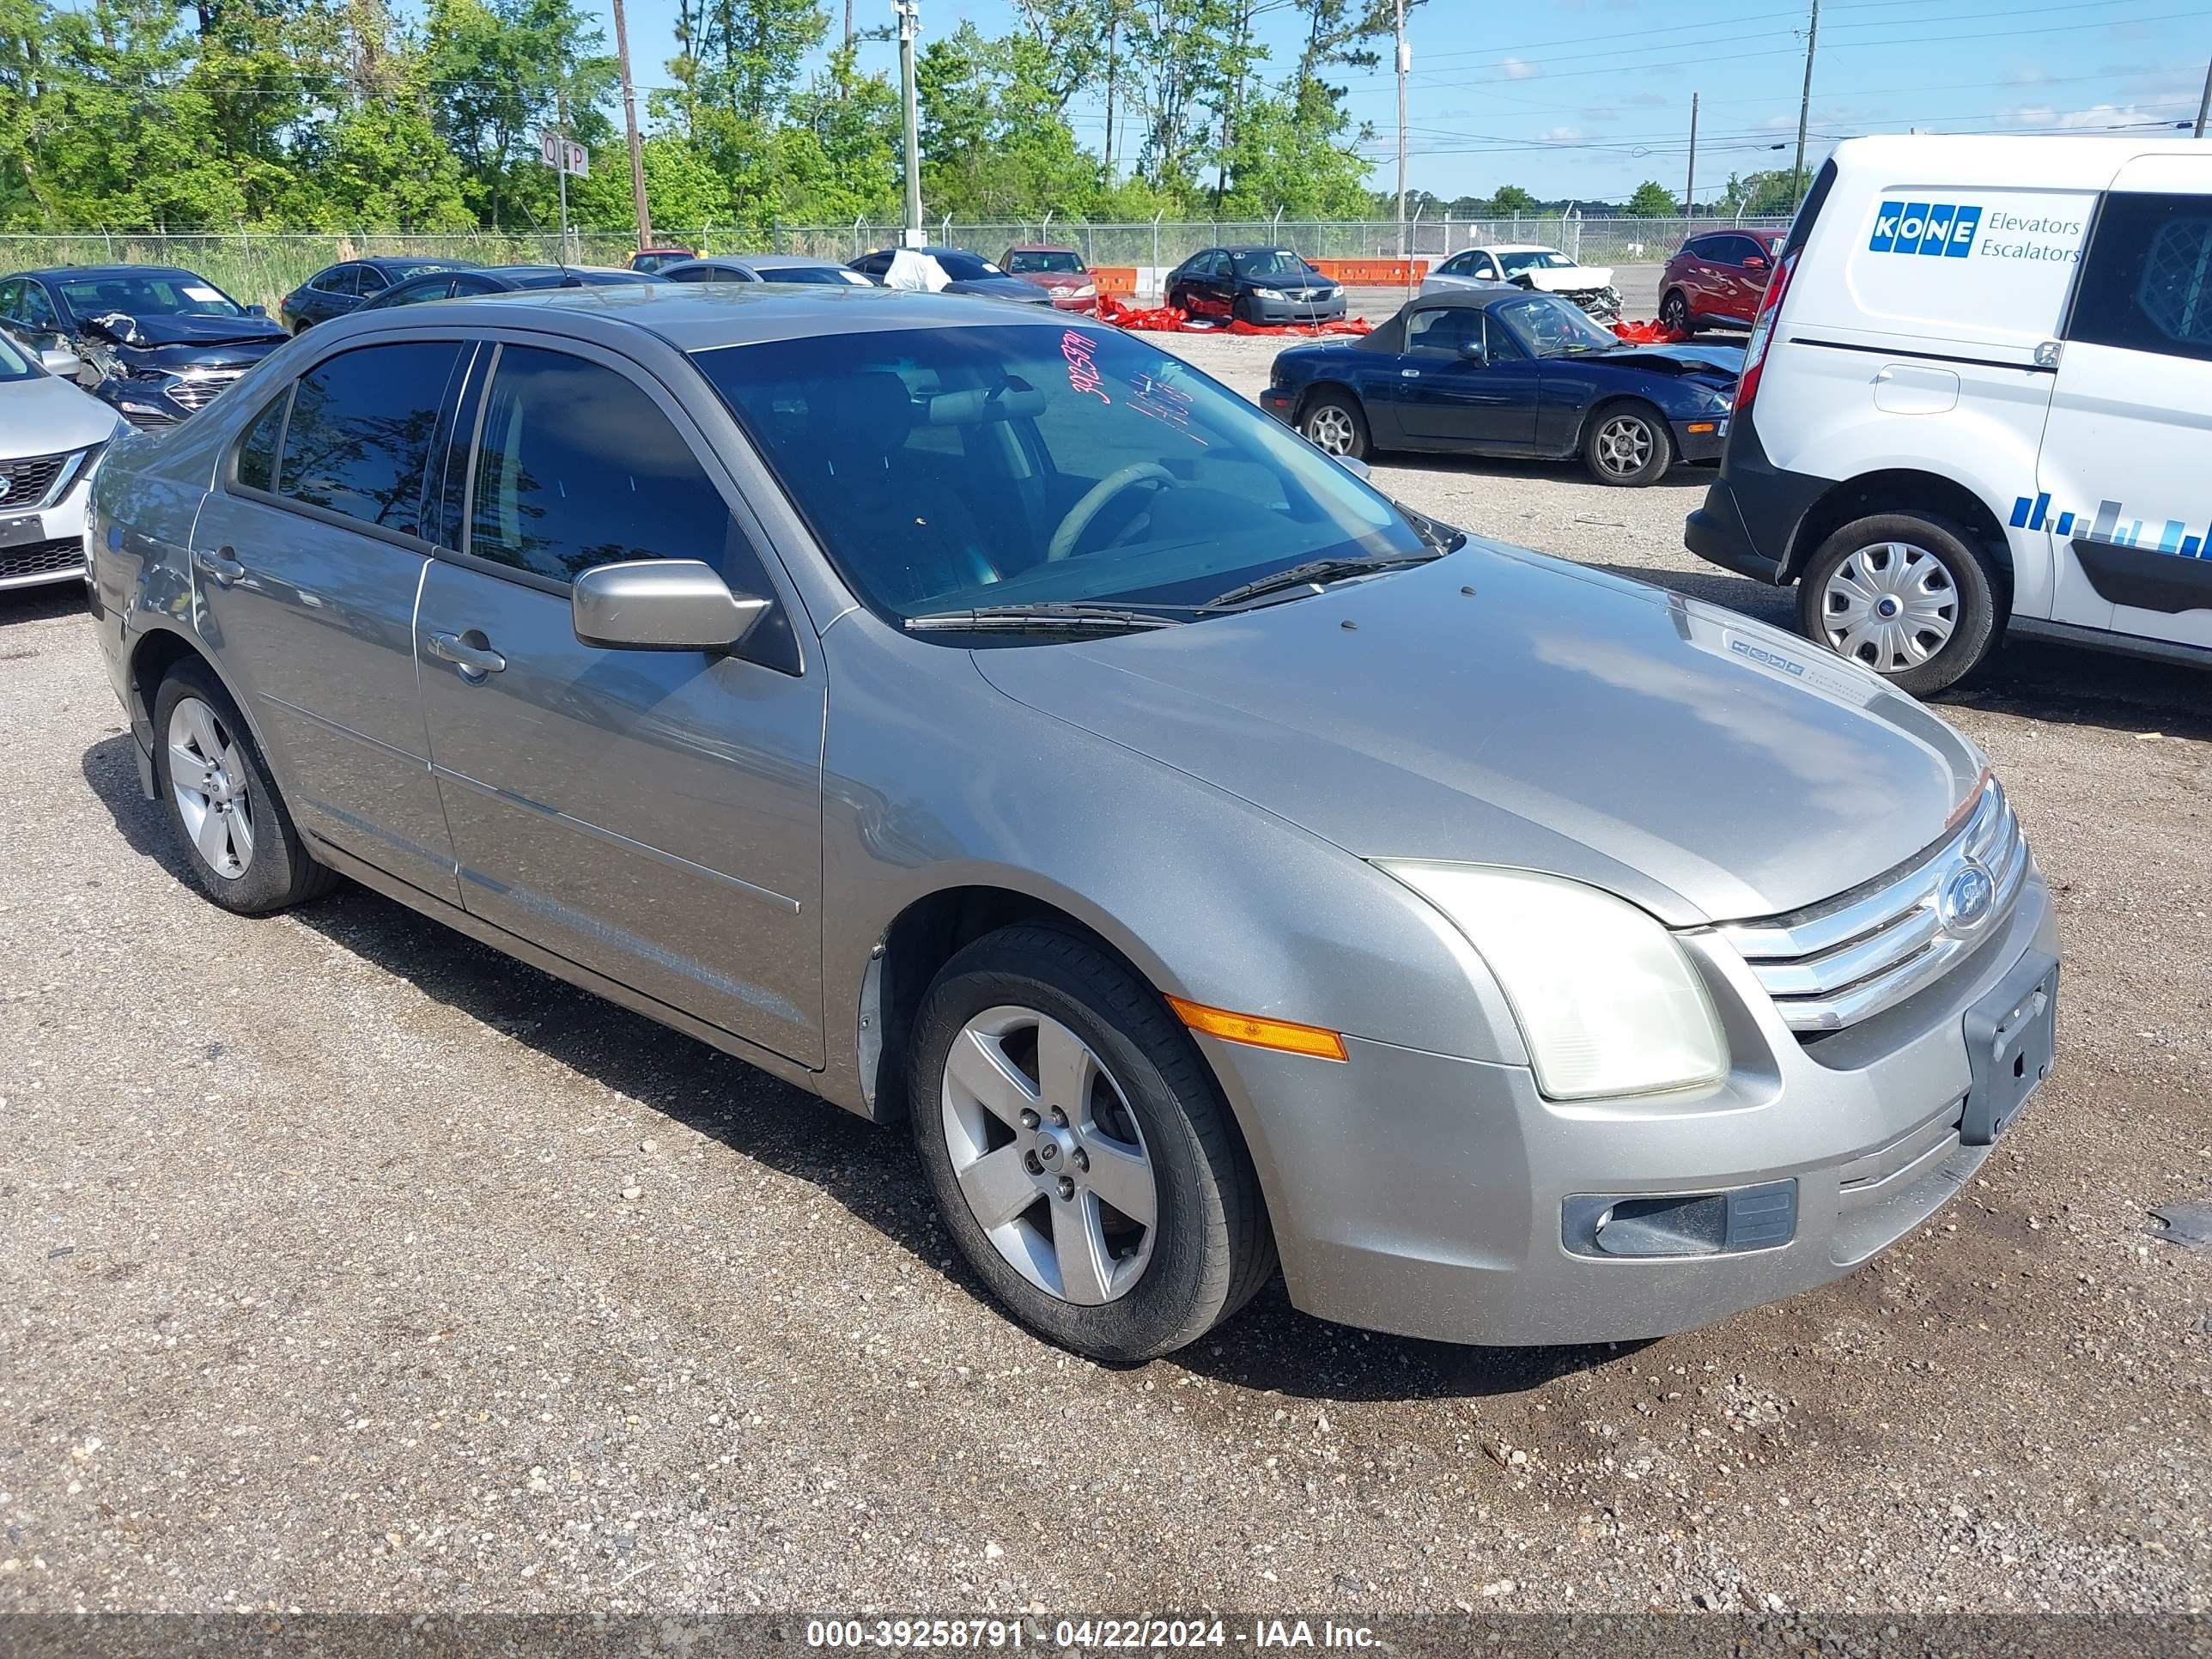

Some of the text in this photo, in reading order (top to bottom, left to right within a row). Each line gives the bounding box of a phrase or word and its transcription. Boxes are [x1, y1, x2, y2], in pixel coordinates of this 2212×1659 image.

[545, 137, 558, 167] Q
[574, 148, 582, 172] P
[1875, 216, 1975, 244] KONE
[1988, 212, 2081, 236] Elevators
[1980, 239, 2082, 264] Escalators
[1060, 329, 1111, 404] 39258791
